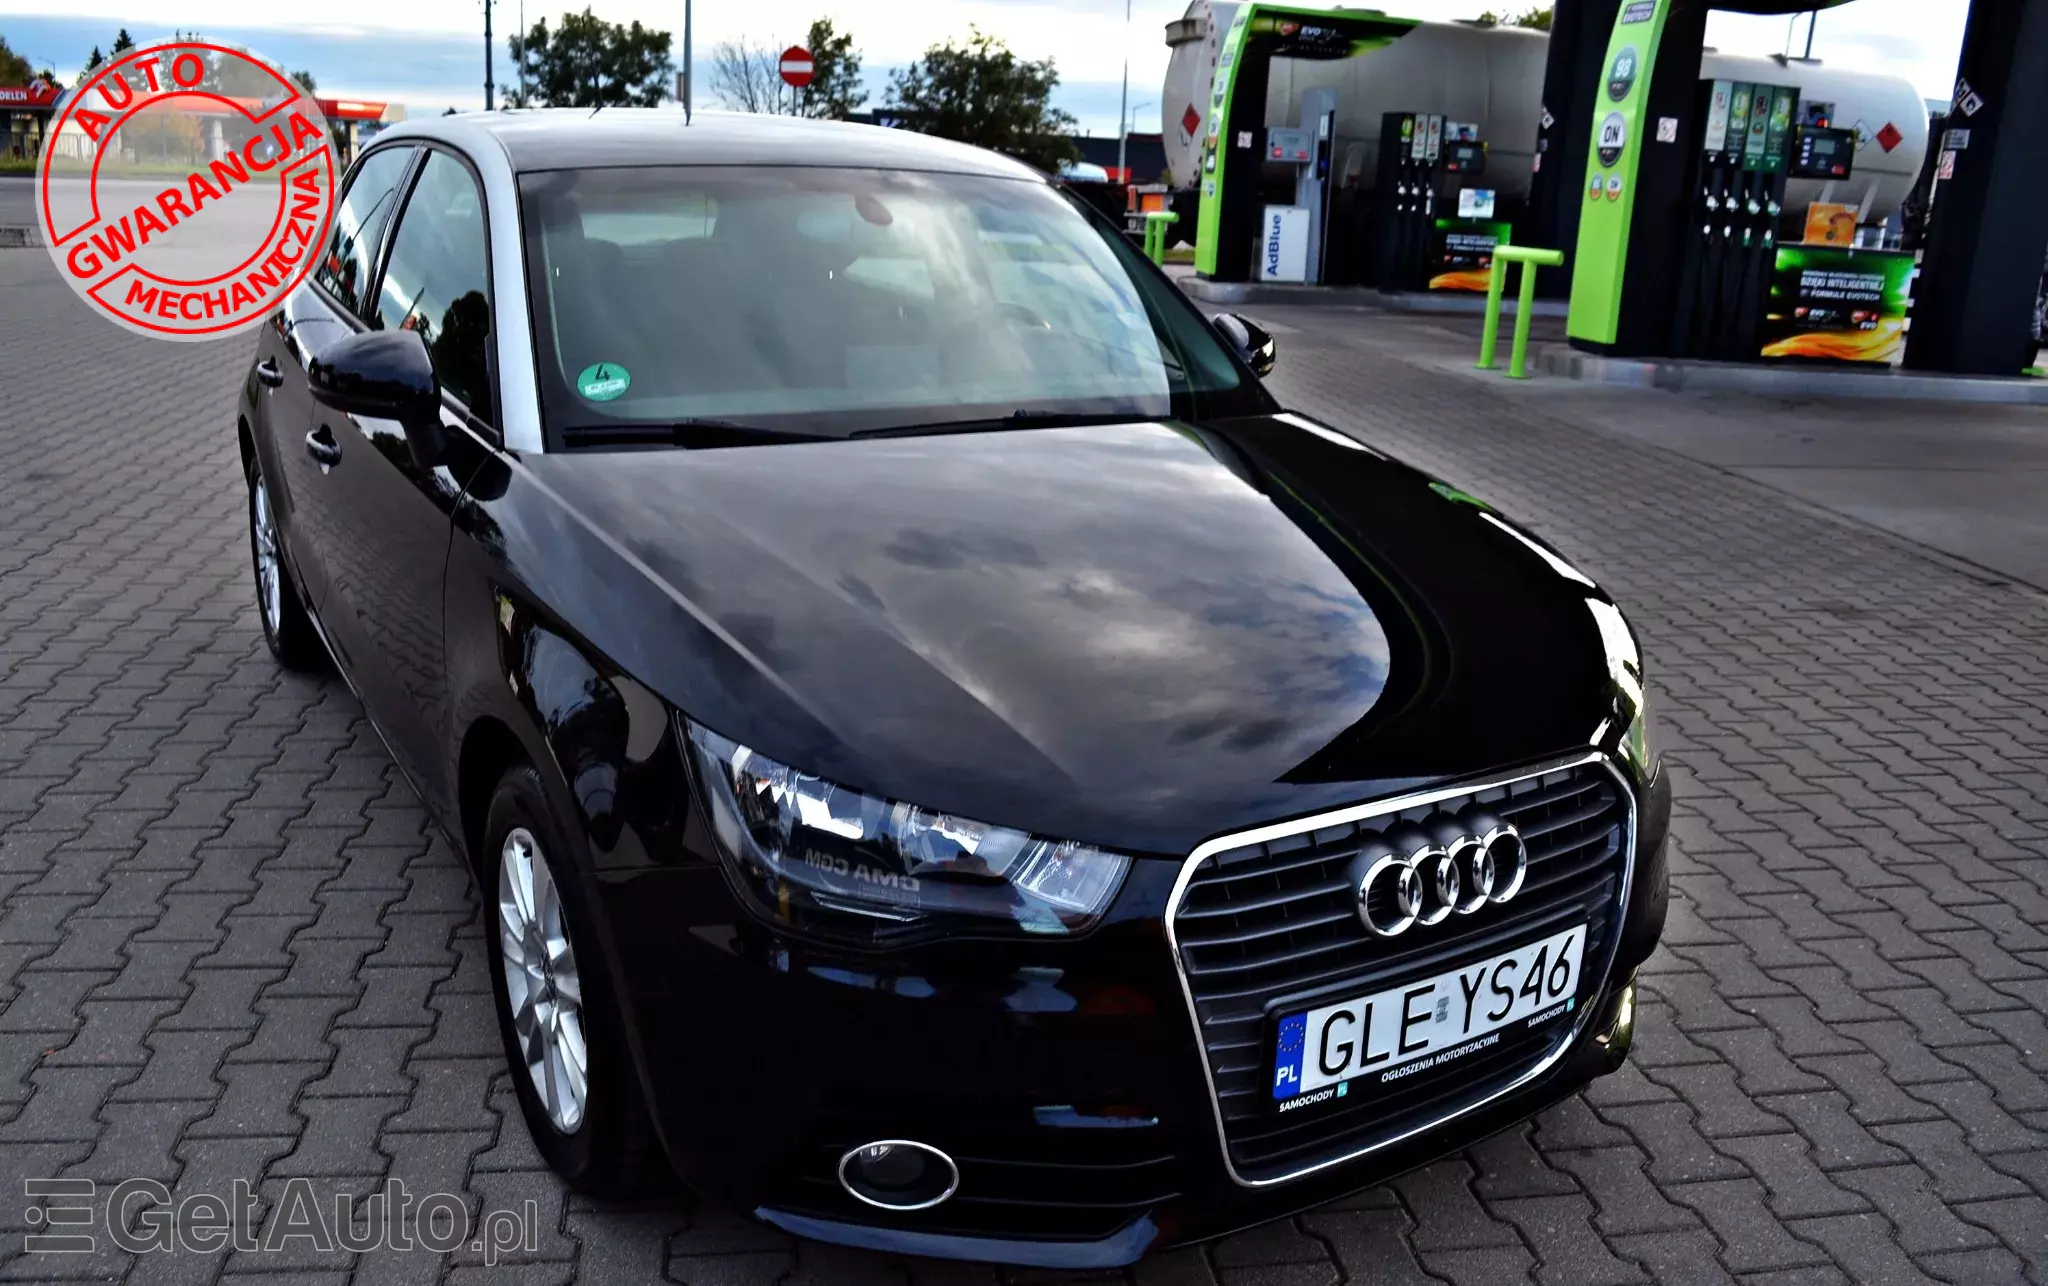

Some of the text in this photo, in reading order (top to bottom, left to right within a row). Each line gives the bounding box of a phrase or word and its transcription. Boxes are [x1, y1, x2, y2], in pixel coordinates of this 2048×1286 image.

[1615, 58, 1632, 78] 98
[1604, 125, 1620, 143] ON
[1267, 214, 1282, 276] AdBlue
[595, 363, 611, 381] 4
[1319, 935, 1576, 1077] GLE YS46
[1527, 1003, 1566, 1028] SAMOCHODY
[1381, 1032, 1500, 1083] OGŁOSZENIA MOTORYZACYJNE
[1276, 1064, 1298, 1087] PL
[1279, 1088, 1335, 1113] SAMOCHODY
